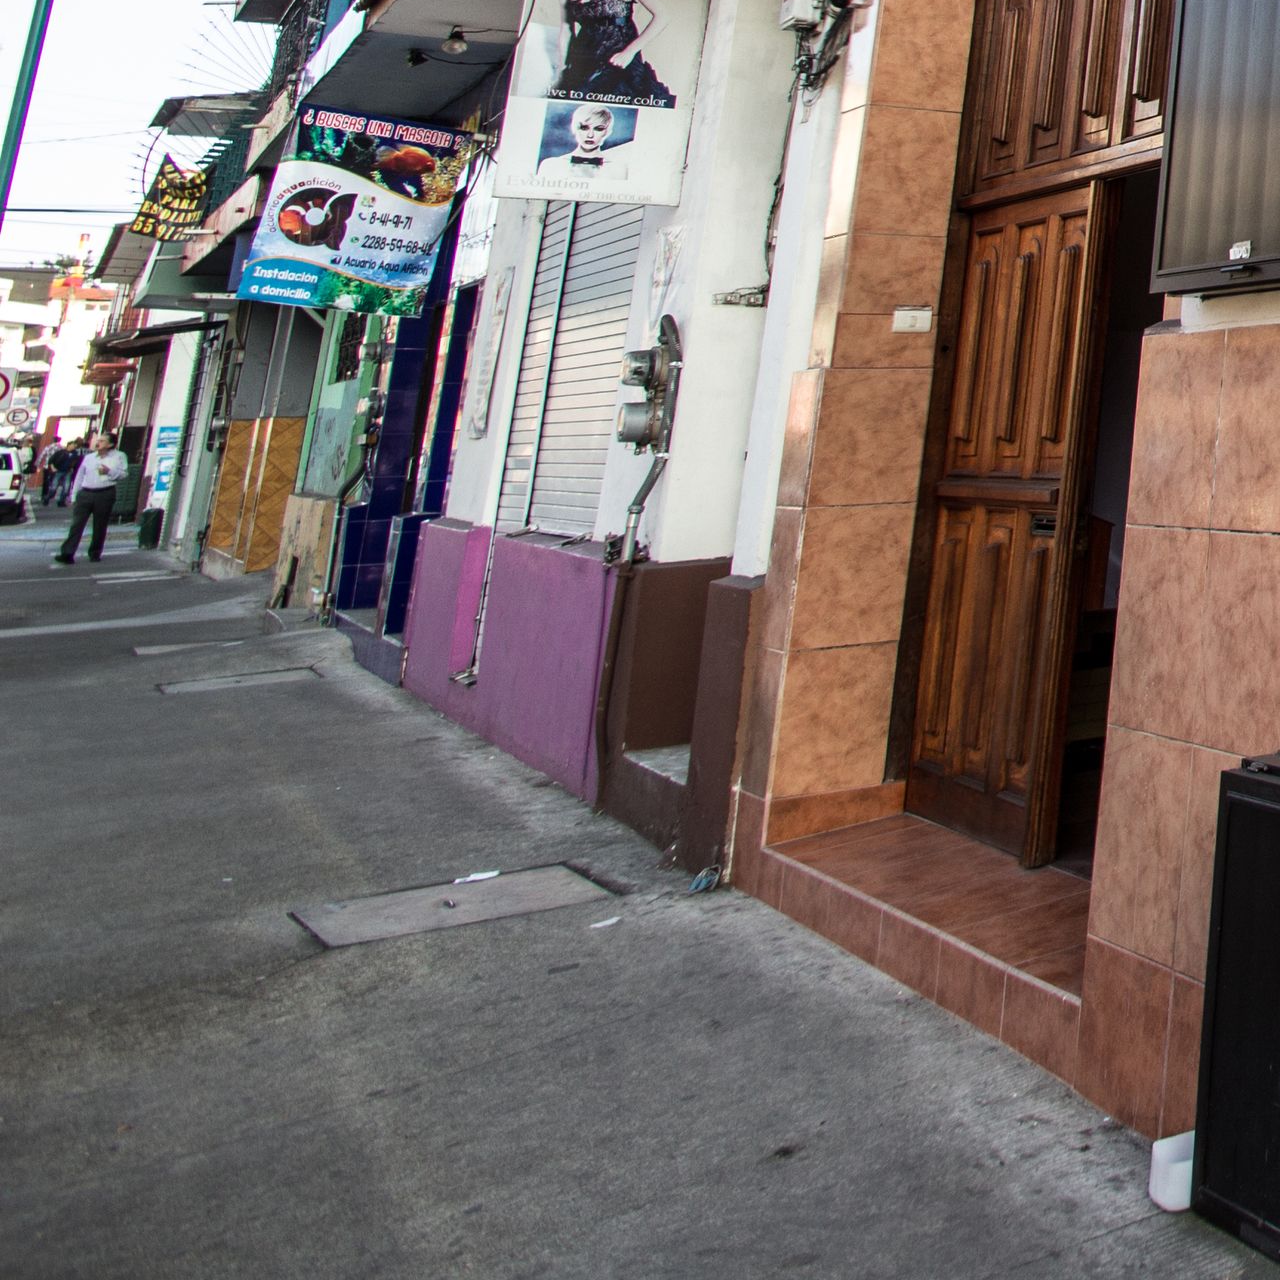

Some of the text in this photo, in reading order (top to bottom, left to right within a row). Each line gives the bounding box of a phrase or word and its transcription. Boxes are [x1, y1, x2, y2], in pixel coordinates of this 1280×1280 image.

[570, 90, 584, 99] to
[585, 91, 631, 104] couture
[633, 94, 667, 107] color
[367, 119, 394, 138] UNA
[394, 124, 453, 147] MASCOTA
[506, 174, 590, 190] Evolution
[344, 256, 377, 270] Acuario
[379, 260, 399, 273] Aqua
[249, 284, 312, 300] a domicilio
